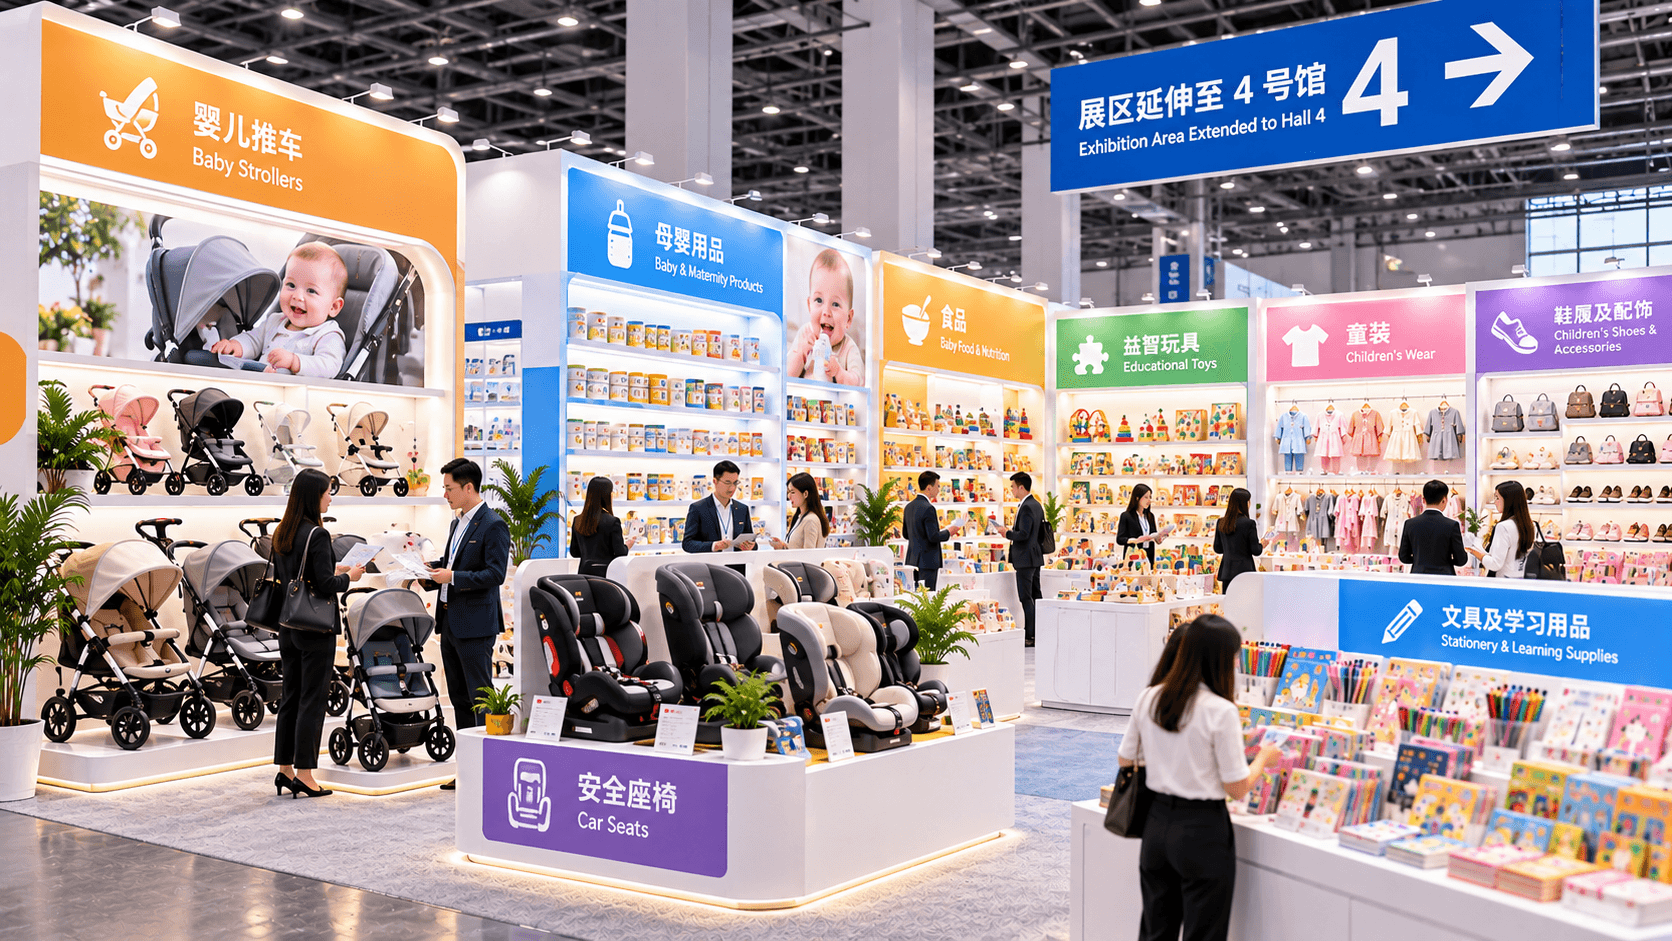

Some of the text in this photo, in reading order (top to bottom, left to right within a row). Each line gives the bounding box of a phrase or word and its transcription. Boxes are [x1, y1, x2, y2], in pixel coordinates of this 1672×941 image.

[1078, 61, 1327, 131] 展区延伸至 4 号馆
[1342, 37, 1409, 127] 4
[193, 101, 303, 162] 婴儿推车
[1079, 107, 1326, 157] Exhibition Area Extended to Hall 4
[193, 146, 303, 192] Baby Strollers
[655, 221, 724, 265] 母婴用品
[655, 256, 764, 294] Baby & Maternity Products
[941, 303, 967, 334] 食品
[1346, 320, 1391, 346] 童装
[1554, 324, 1657, 341] Children's Shoes &
[940, 336, 1010, 362] Baby Food & Nutrition
[1123, 332, 1200, 356] 益智玩具
[1346, 348, 1436, 363] Children's Wear
[1554, 341, 1622, 355] Accessories
[1123, 358, 1217, 373] Educational Toys
[1441, 604, 1591, 640] 文具及学习用品
[1441, 634, 1619, 665] Stationery & Learning Supplies
[578, 771, 678, 815] 安全座椅
[577, 811, 649, 838] Car Seats
